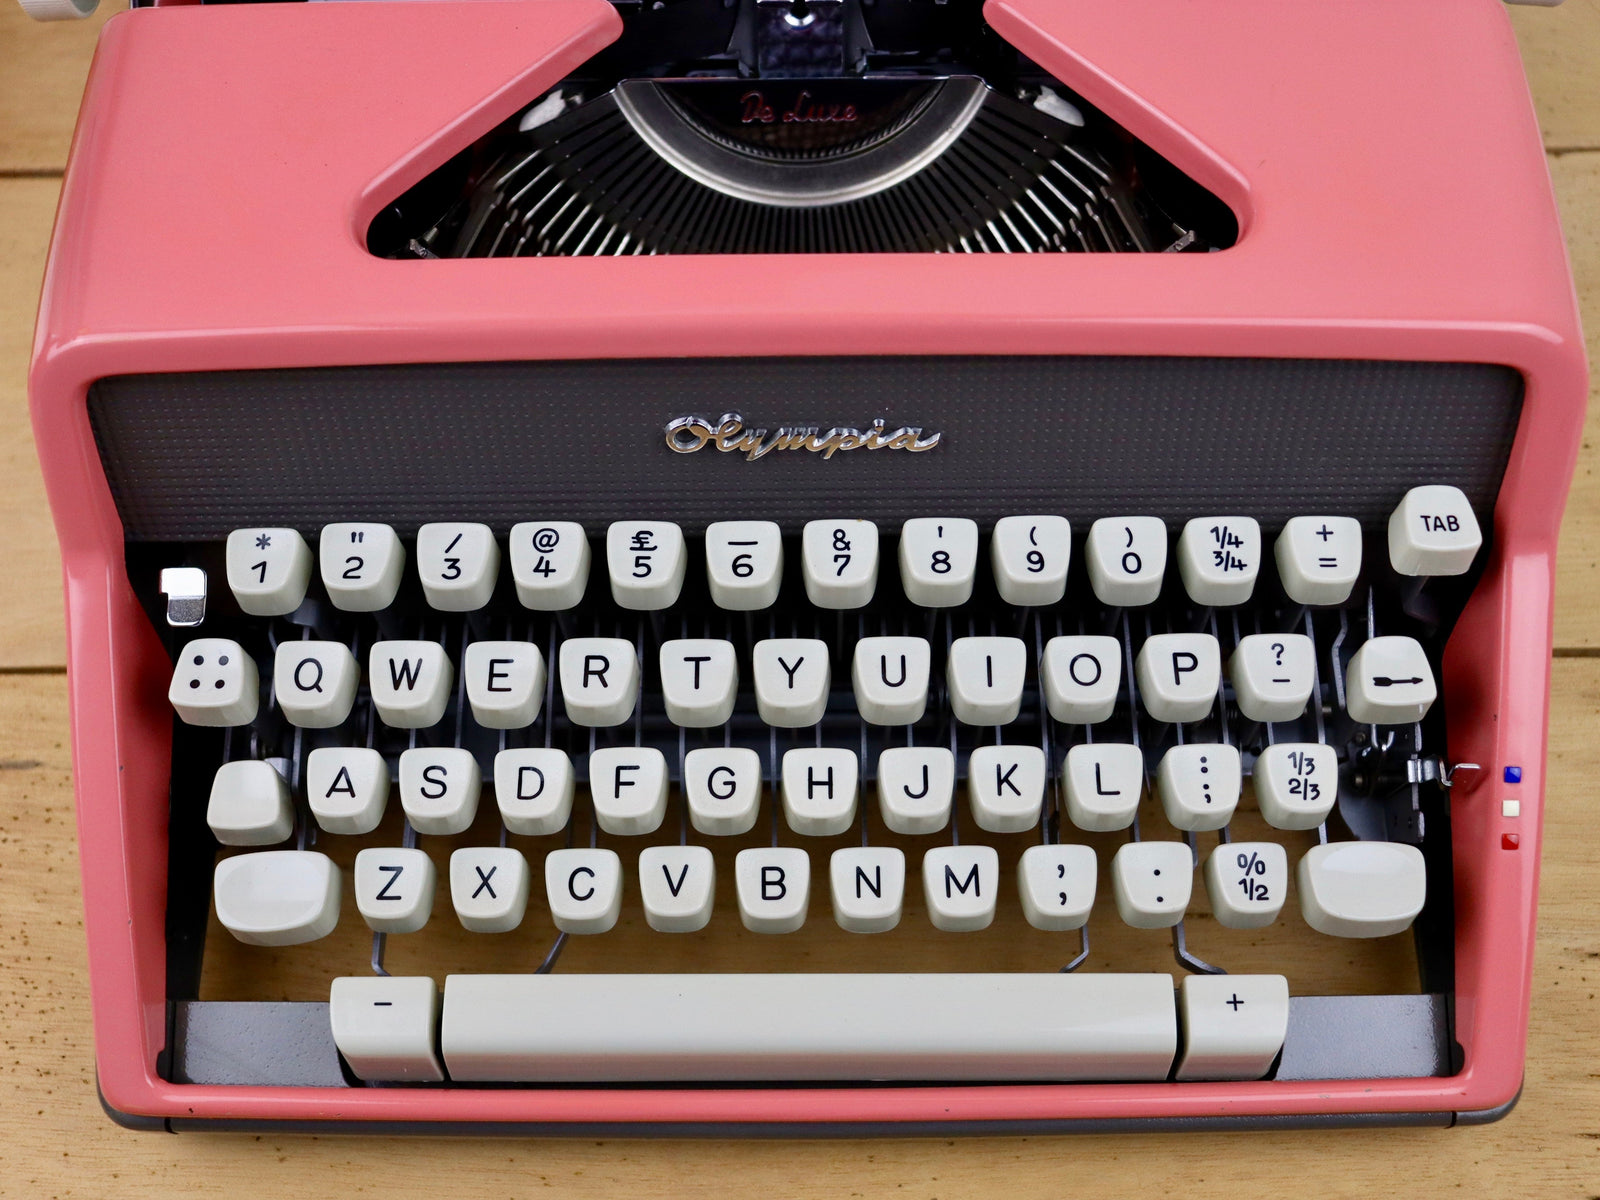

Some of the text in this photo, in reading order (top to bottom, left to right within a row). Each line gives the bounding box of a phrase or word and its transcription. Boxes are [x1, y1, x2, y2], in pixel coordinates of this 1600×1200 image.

[740, 90, 857, 123] De Luxe
[664, 412, 941, 461] Olympia
[832, 528, 851, 552] &
[1315, 524, 1334, 542] +
[1419, 514, 1460, 532] TAB
[532, 527, 560, 554] @
[629, 530, 658, 552] £
[250, 560, 268, 584] 1
[342, 556, 364, 580] 2
[441, 557, 462, 581] 3
[532, 555, 557, 578] 4
[632, 555, 652, 579] 5
[731, 553, 754, 578] 6
[833, 554, 852, 577] 7
[930, 550, 952, 574] 8
[1026, 550, 1045, 573] 9
[1318, 556, 1338, 568] =
[880, 654, 907, 688] U
[986, 654, 993, 688] I
[1069, 653, 1102, 687] O
[1171, 651, 1199, 686] P
[1271, 642, 1285, 666] ?
[293, 657, 323, 694] Q
[388, 657, 423, 691] W
[487, 658, 515, 693] E
[582, 654, 610, 689] R
[683, 656, 712, 690] T
[777, 656, 805, 690] Y
[325, 766, 356, 799] A
[420, 765, 448, 800] S
[516, 766, 545, 801] D
[614, 765, 641, 799] F
[707, 765, 737, 800] G
[807, 766, 834, 800] H
[903, 764, 929, 800] J
[996, 763, 1022, 797] K
[1095, 762, 1121, 796] L
[661, 863, 689, 898] V
[1236, 851, 1267, 876] %
[375, 865, 404, 901] Z
[471, 865, 497, 900] X
[567, 866, 596, 902] C
[760, 866, 787, 901] B
[855, 865, 882, 899] N
[944, 863, 981, 899] M
[1225, 993, 1245, 1012] +
